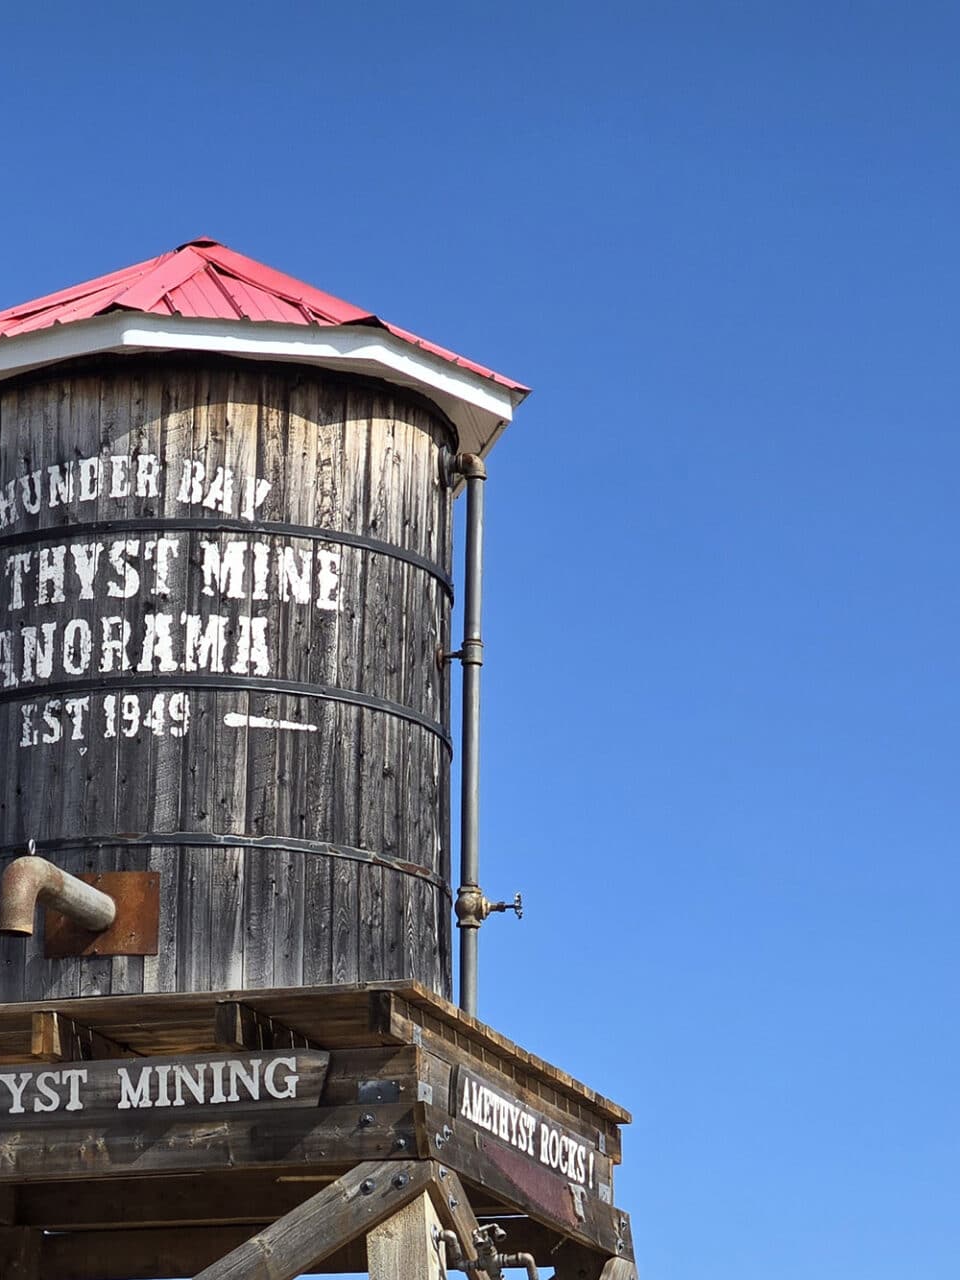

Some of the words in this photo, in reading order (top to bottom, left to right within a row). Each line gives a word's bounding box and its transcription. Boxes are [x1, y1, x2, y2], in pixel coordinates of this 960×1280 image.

[175, 458, 272, 521] BAY
[200, 539, 344, 611] MINE
[19, 695, 90, 748] EST
[103, 692, 191, 740] 1949
[117, 1056, 301, 1110] MINING
[460, 1076, 537, 1157] AMETHYST
